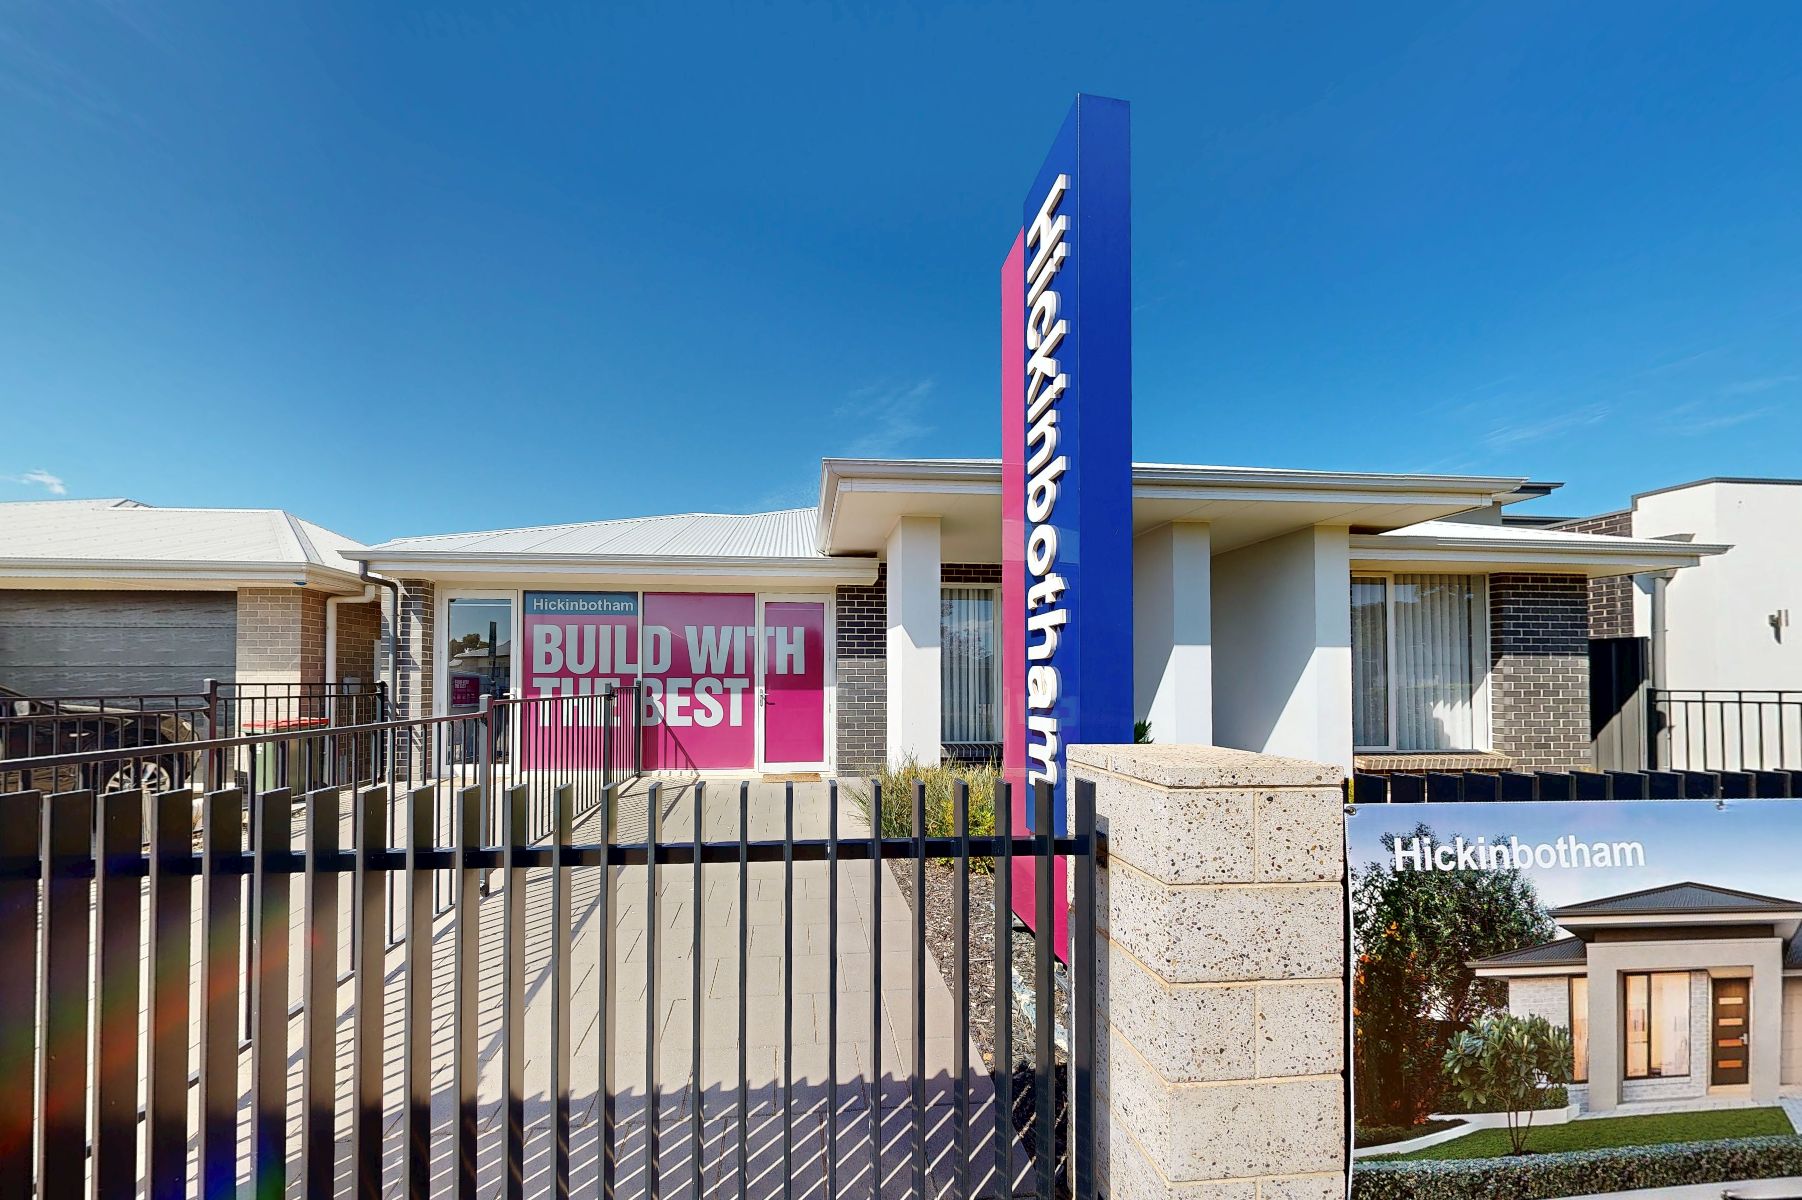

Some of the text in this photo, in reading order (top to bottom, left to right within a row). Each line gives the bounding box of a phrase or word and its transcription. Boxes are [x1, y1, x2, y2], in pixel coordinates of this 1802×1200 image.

[1027, 173, 1071, 788] Hickinbotham
[533, 598, 634, 612] Hickinbotham
[532, 624, 806, 675] BUILD WITH
[633, 676, 750, 727] BEST
[1393, 835, 1646, 872] Hickinbotham
